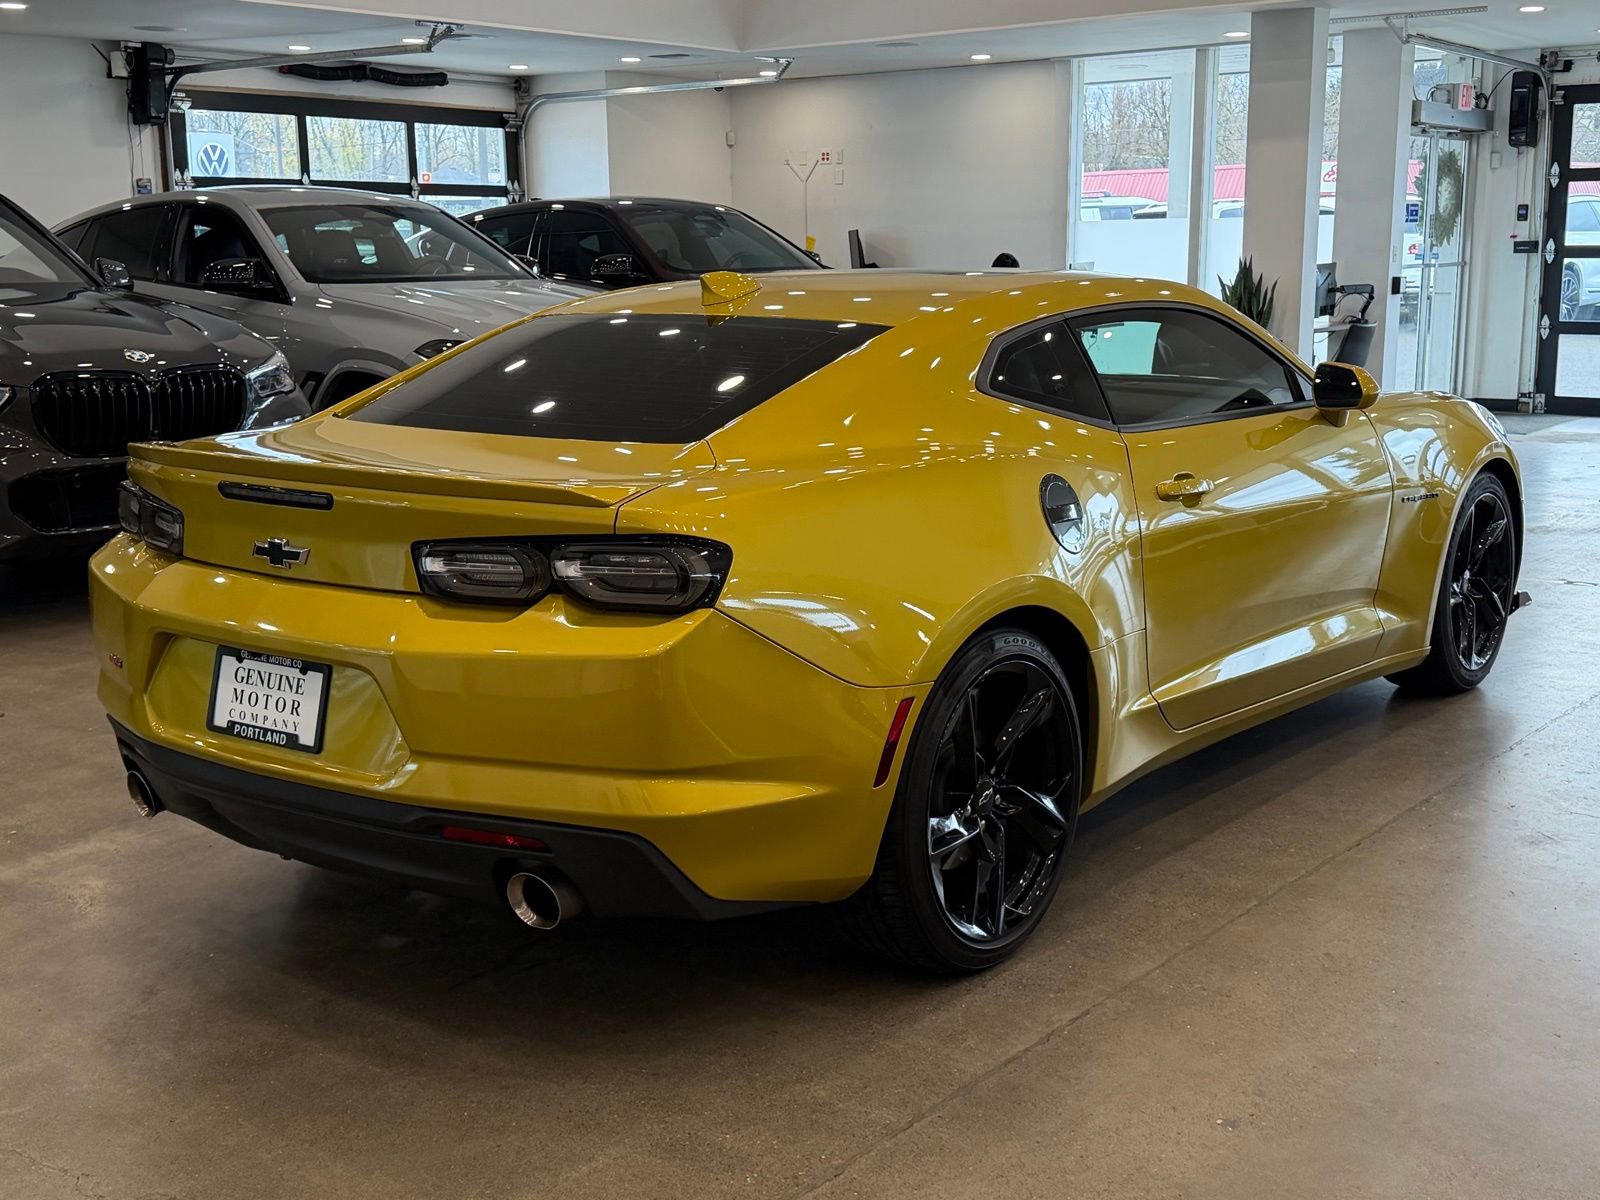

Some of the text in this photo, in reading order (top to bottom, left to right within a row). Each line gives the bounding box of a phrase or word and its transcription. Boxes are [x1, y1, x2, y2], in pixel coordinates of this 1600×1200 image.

[269, 656, 292, 667] MOTOR
[293, 659, 302, 668] CO
[234, 666, 305, 695] GENUINE
[231, 688, 301, 716] MOTOR
[229, 708, 299, 732] COMPANY
[234, 725, 287, 745] PORTLAND
